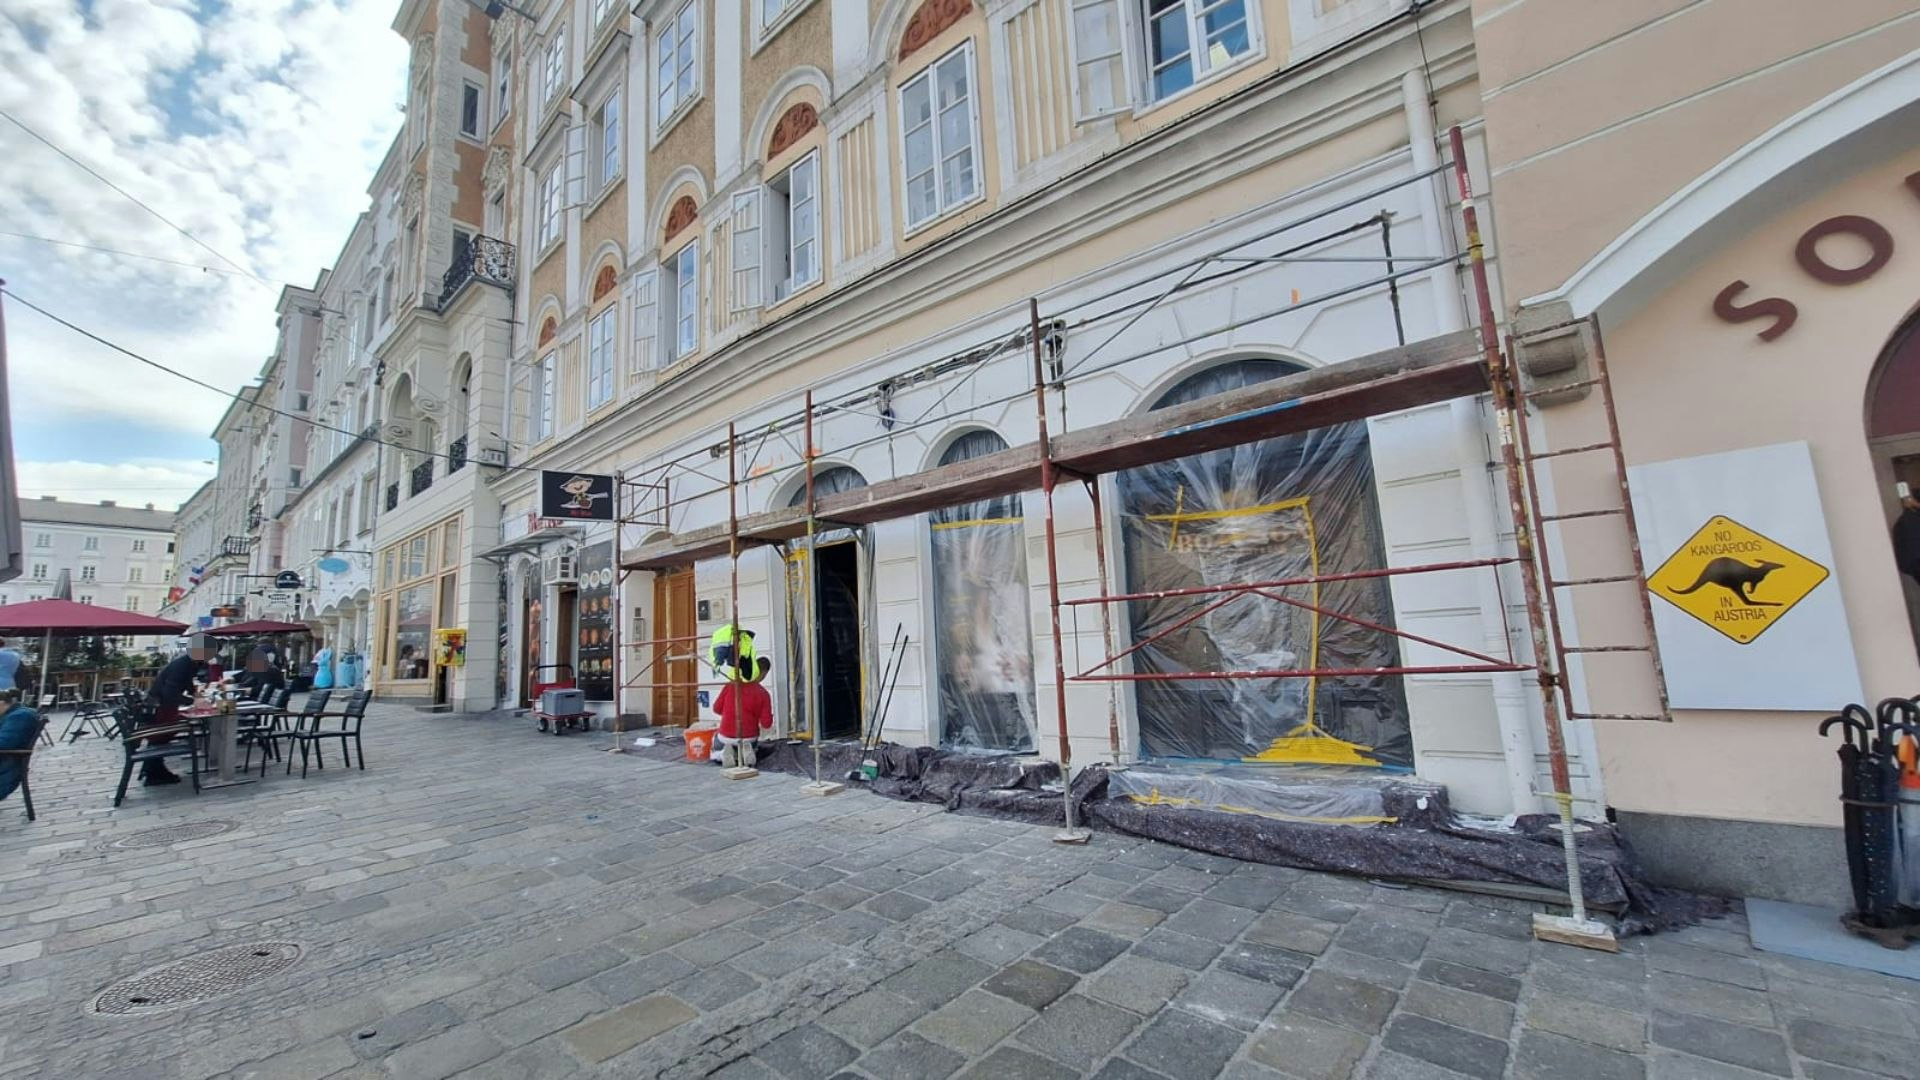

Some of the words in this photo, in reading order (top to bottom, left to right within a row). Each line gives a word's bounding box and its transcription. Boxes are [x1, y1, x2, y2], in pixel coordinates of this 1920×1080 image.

[1713, 171, 1920, 342] SO
[1714, 530, 1732, 542] NO
[1691, 540, 1762, 556] KANGAROOS
[1720, 596, 1733, 608] IN
[1714, 608, 1767, 622] AUSTRIA
